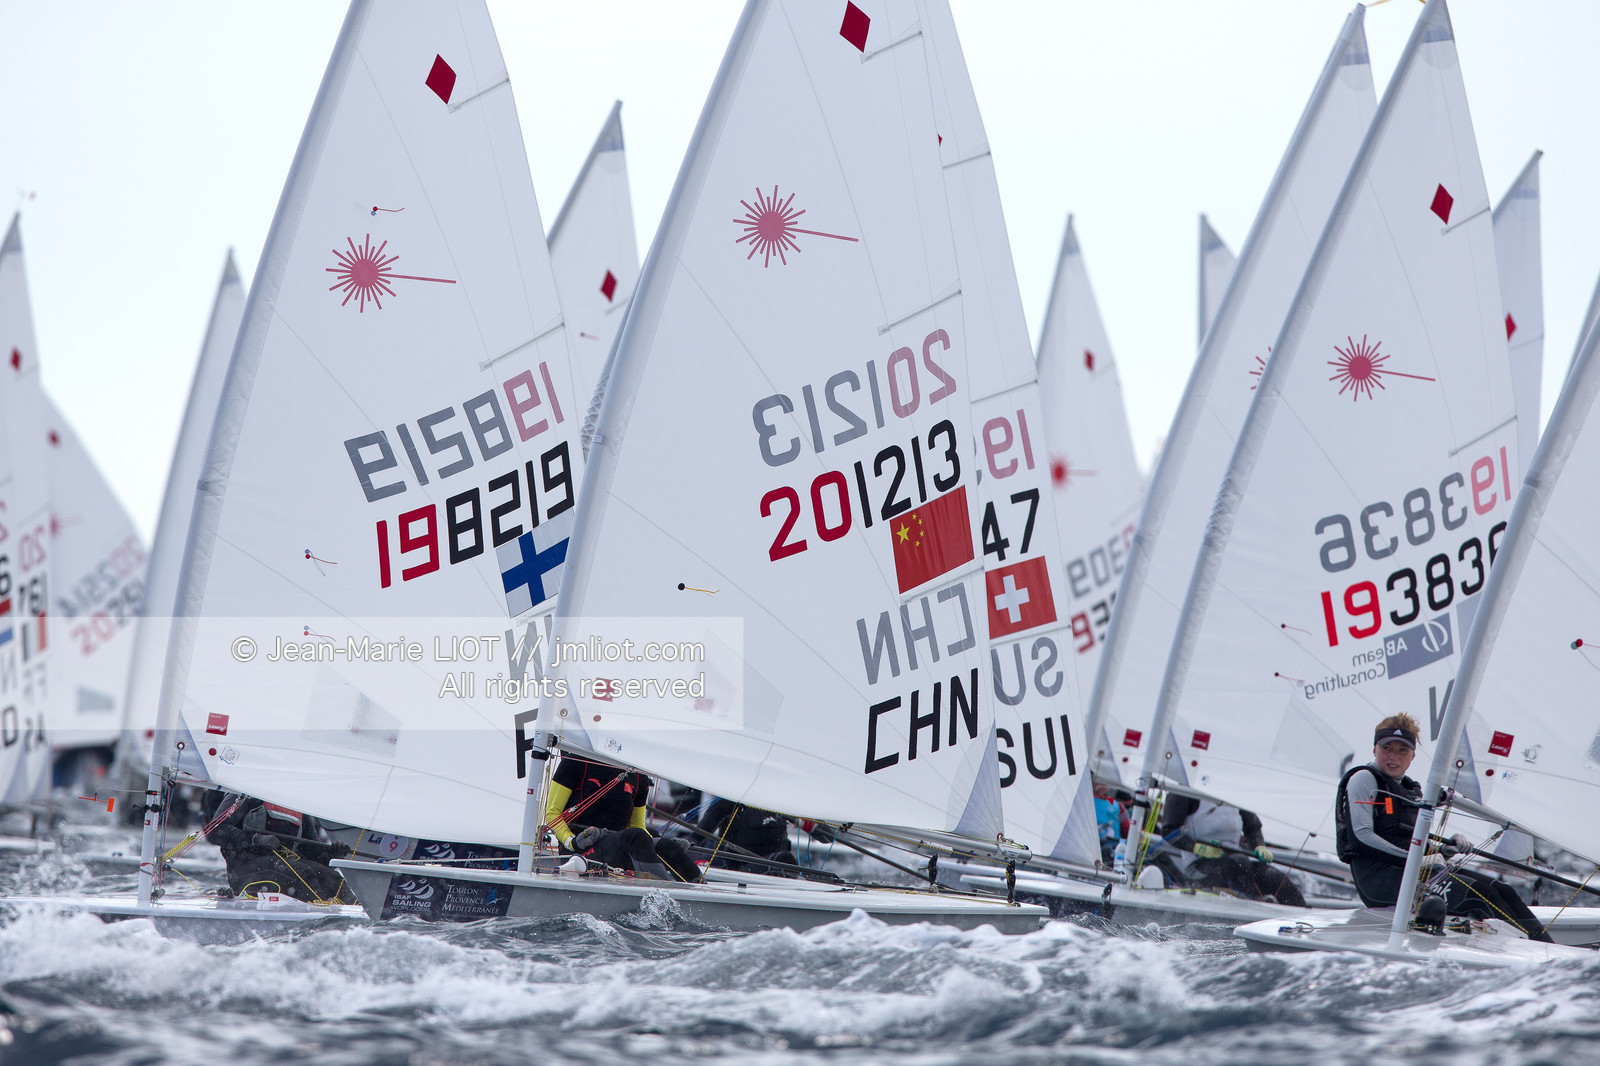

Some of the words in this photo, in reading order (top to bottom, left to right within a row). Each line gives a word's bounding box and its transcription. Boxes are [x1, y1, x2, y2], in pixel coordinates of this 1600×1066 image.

[759, 419, 961, 562] 201213
[376, 440, 575, 589] 198219
[865, 667, 978, 775] CHN
[996, 714, 1077, 789] SUI
[389, 841, 398, 852] 9
[391, 899, 432, 908] SAILING
[445, 893, 484, 905] PROVENCE
[447, 884, 479, 895] TOULON
